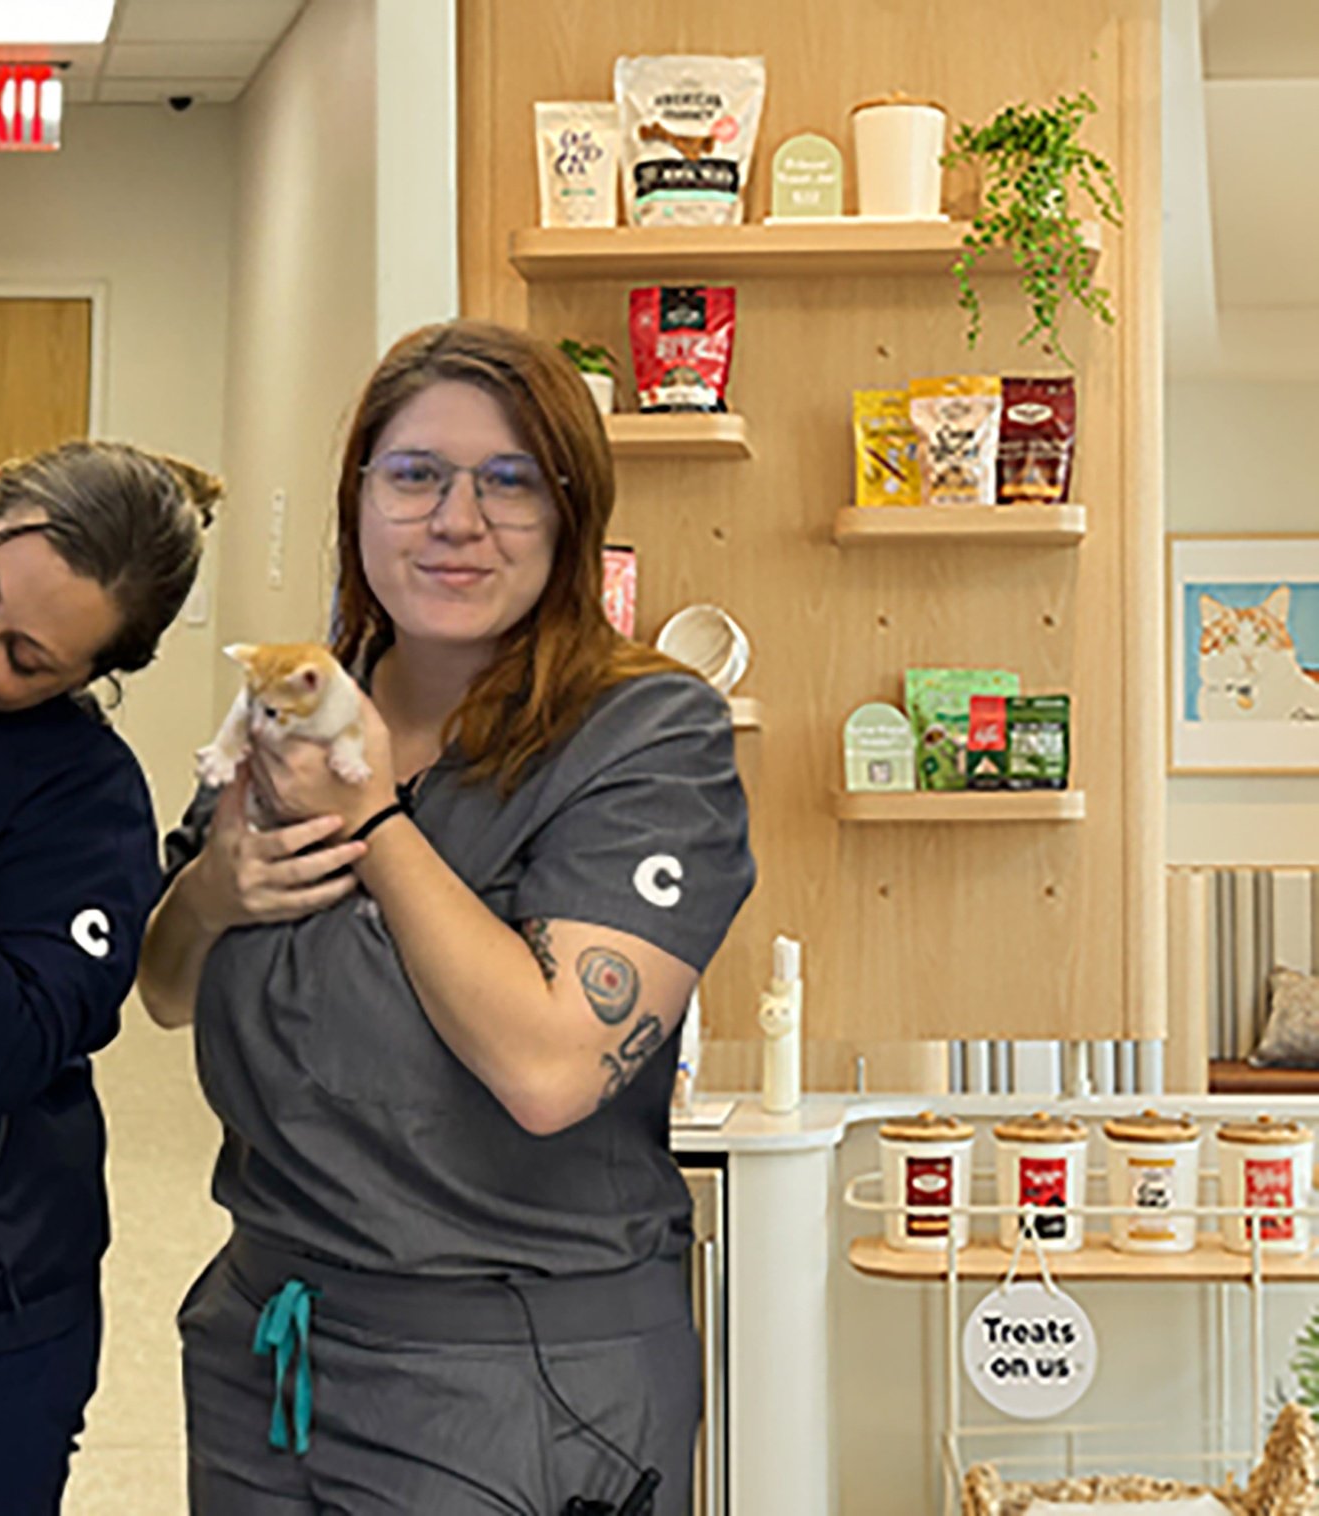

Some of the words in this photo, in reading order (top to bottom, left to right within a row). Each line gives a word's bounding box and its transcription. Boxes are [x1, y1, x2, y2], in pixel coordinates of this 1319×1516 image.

[633, 853, 683, 908] C
[71, 908, 110, 957] C
[982, 1317, 1075, 1343] Treats
[990, 1357, 1029, 1378] on
[1035, 1357, 1070, 1378] us
